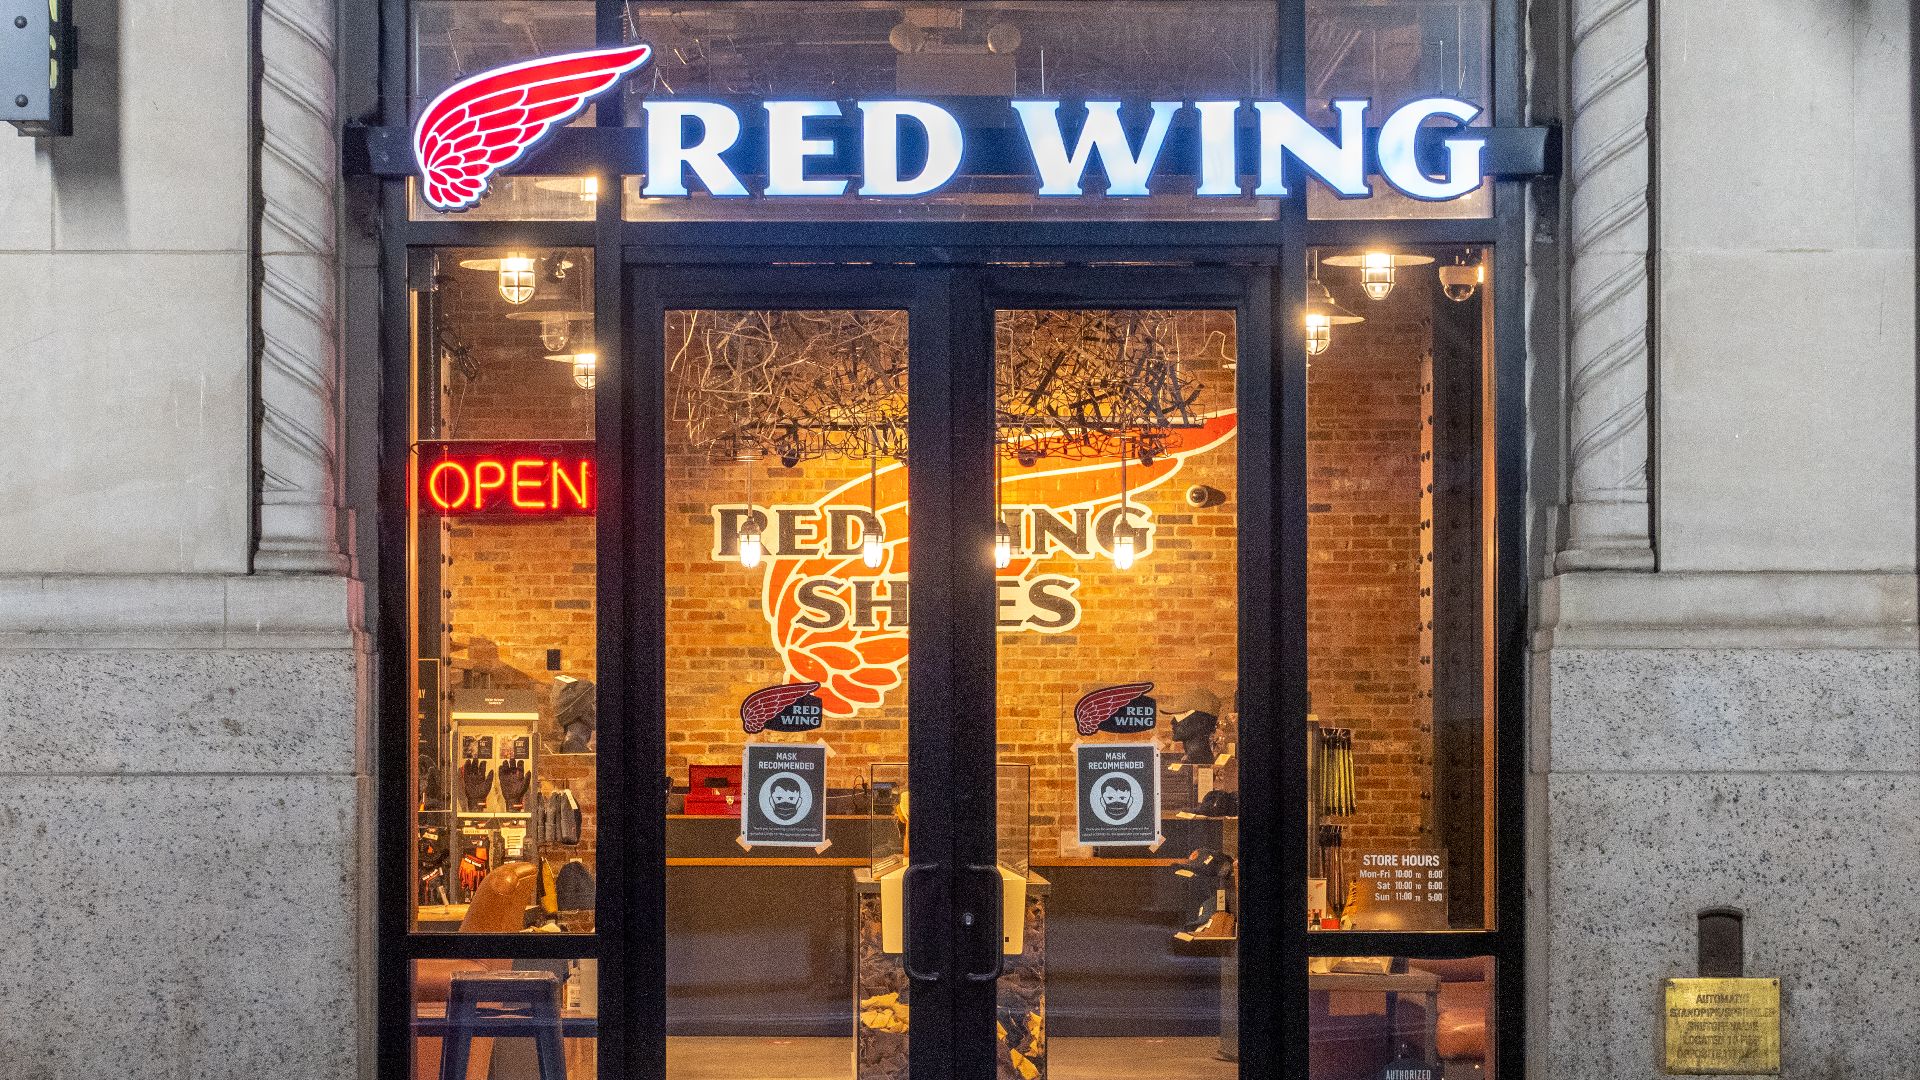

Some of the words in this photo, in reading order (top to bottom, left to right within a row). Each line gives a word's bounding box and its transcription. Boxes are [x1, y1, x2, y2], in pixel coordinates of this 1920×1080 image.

[642, 100, 964, 196] RED
[1010, 98, 1486, 200] WING
[429, 461, 588, 509] OPEN
[717, 507, 885, 557] RED
[795, 579, 1076, 629] SHES
[792, 705, 820, 715] RED
[1126, 706, 1154, 716] RED
[781, 715, 820, 726] WING
[1115, 716, 1154, 727] WING
[776, 752, 798, 761] MASK
[1105, 752, 1127, 760] MASK
[758, 761, 815, 770] RECOMMENDED
[1088, 761, 1145, 770] RECOMMENDED
[1362, 854, 1398, 866] STORE
[1401, 854, 1440, 867] HOURS
[1360, 869, 1391, 878] Mon-Fri
[1395, 869, 1413, 878] 10:00
[1428, 870, 1443, 879] 8:00
[1376, 881, 1391, 890] Sat
[1395, 881, 1413, 890] 10:00
[1427, 881, 1443, 890] 6:00
[1374, 892, 1390, 901] Sun
[1395, 892, 1413, 901] 11:00
[1427, 892, 1443, 902] 5:00
[1695, 993, 1750, 1004] AUTOMATIC
[1386, 1069, 1431, 1080] AUTHORIZED
